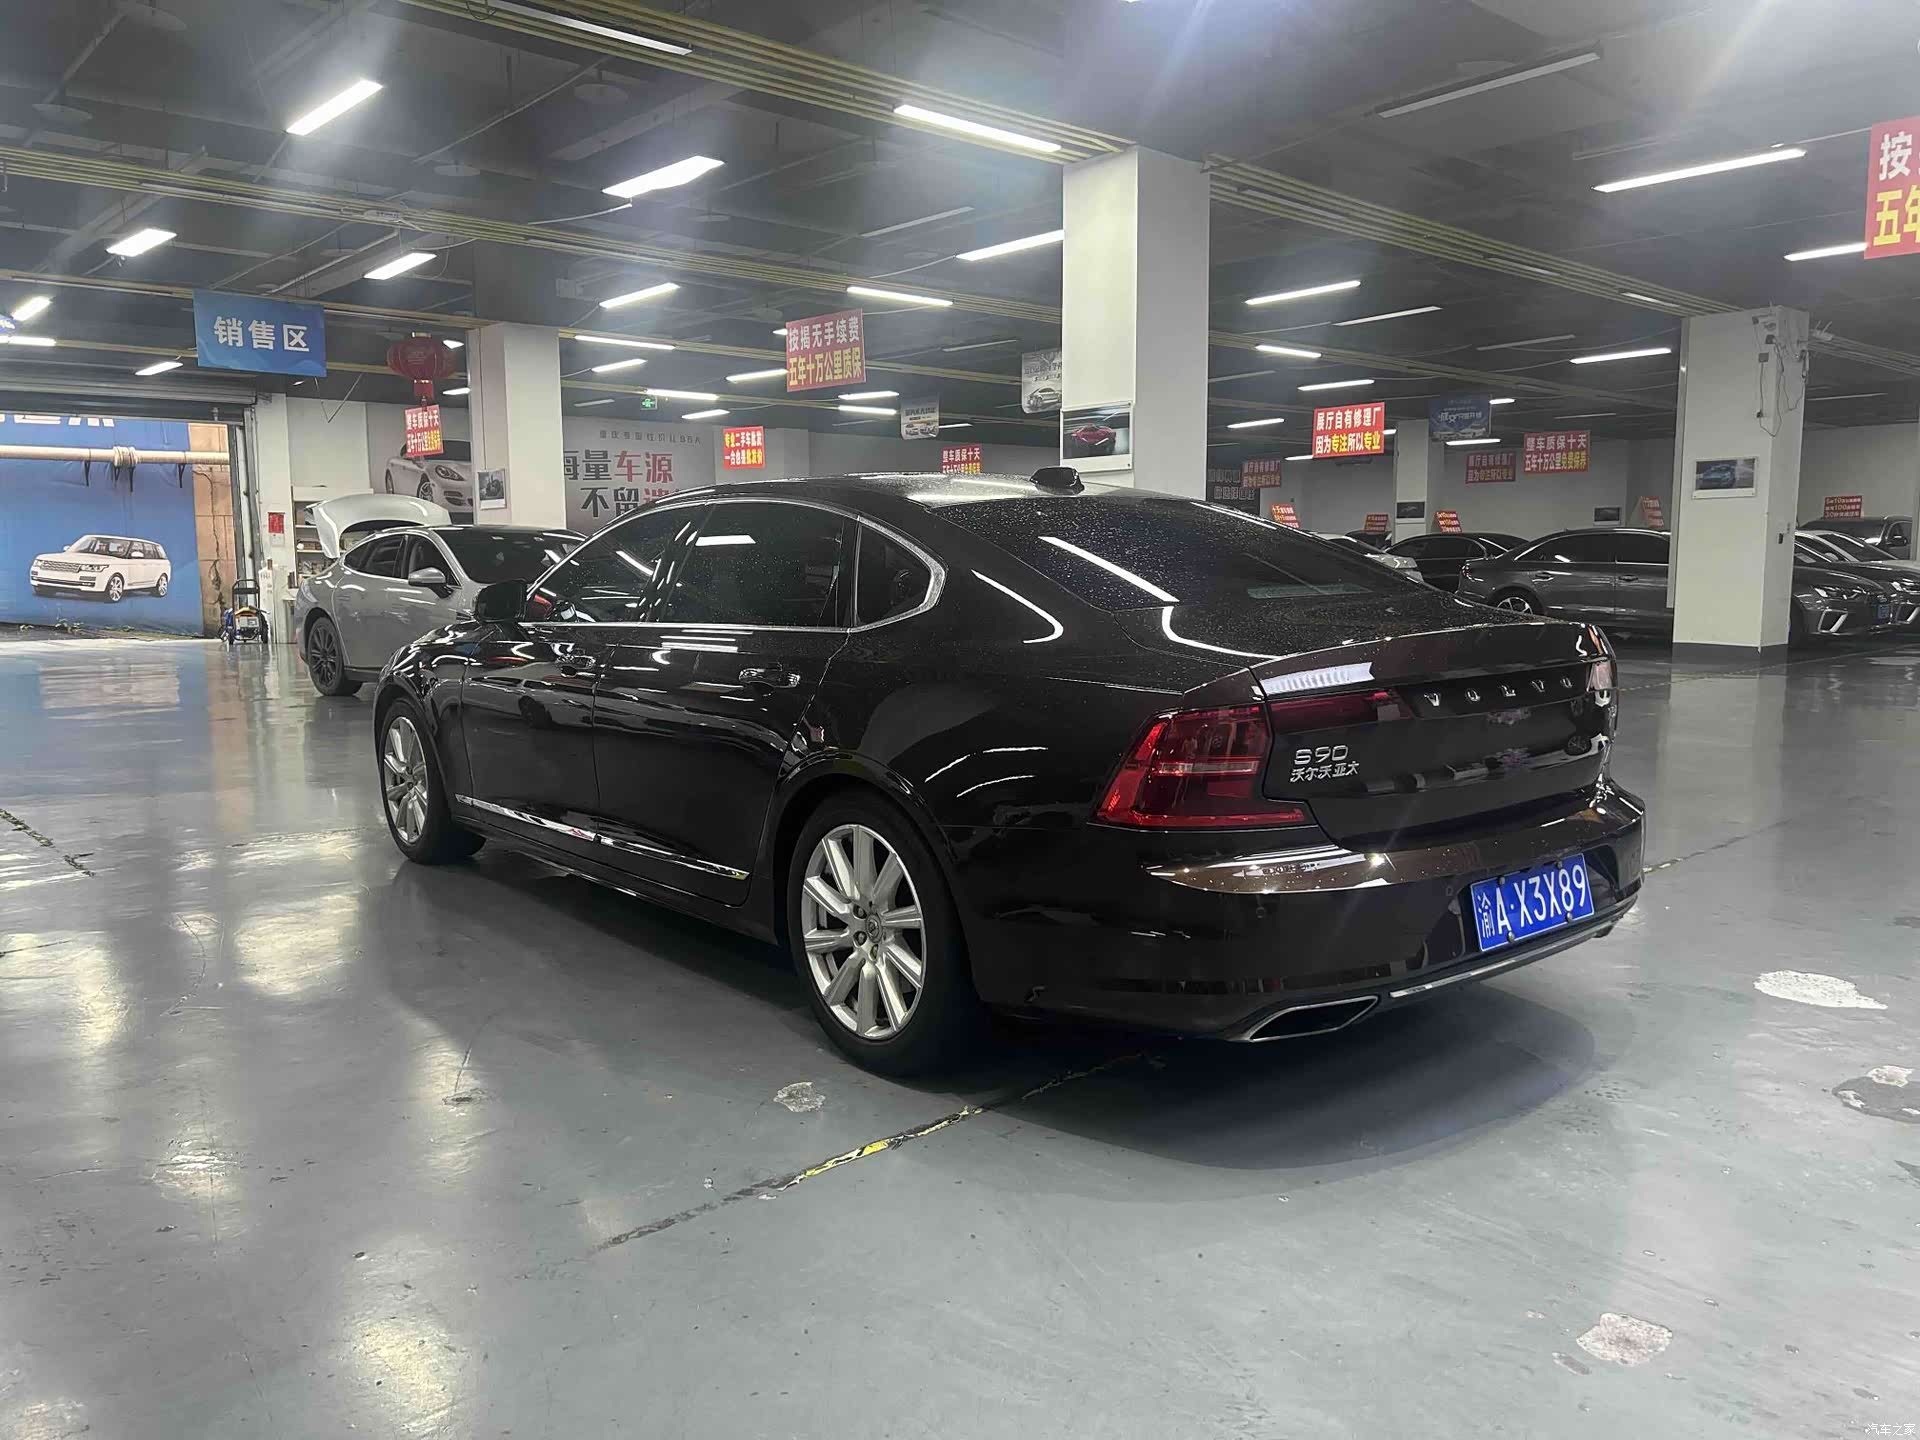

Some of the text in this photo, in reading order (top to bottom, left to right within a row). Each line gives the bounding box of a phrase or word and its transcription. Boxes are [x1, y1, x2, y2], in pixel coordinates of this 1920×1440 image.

[1879, 131, 1920, 181] 按
[213, 316, 310, 352] 销售区
[789, 316, 860, 352] 按揭无手续费
[789, 347, 862, 385] 五年十万公里质保
[1316, 406, 1381, 431] 展厅自有修理厂
[1315, 431, 1380, 454] 因为专注所以专业
[1526, 434, 1587, 452] 整车质保十天
[943, 448, 981, 463] 整车质保十天
[1525, 451, 1588, 472] 五年十万公里免费保养
[580, 487, 681, 518] 不留
[1424, 677, 1573, 706] VOLVO
[1294, 744, 1349, 765] S90
[1289, 761, 1360, 782] 沃尔沃亚太
